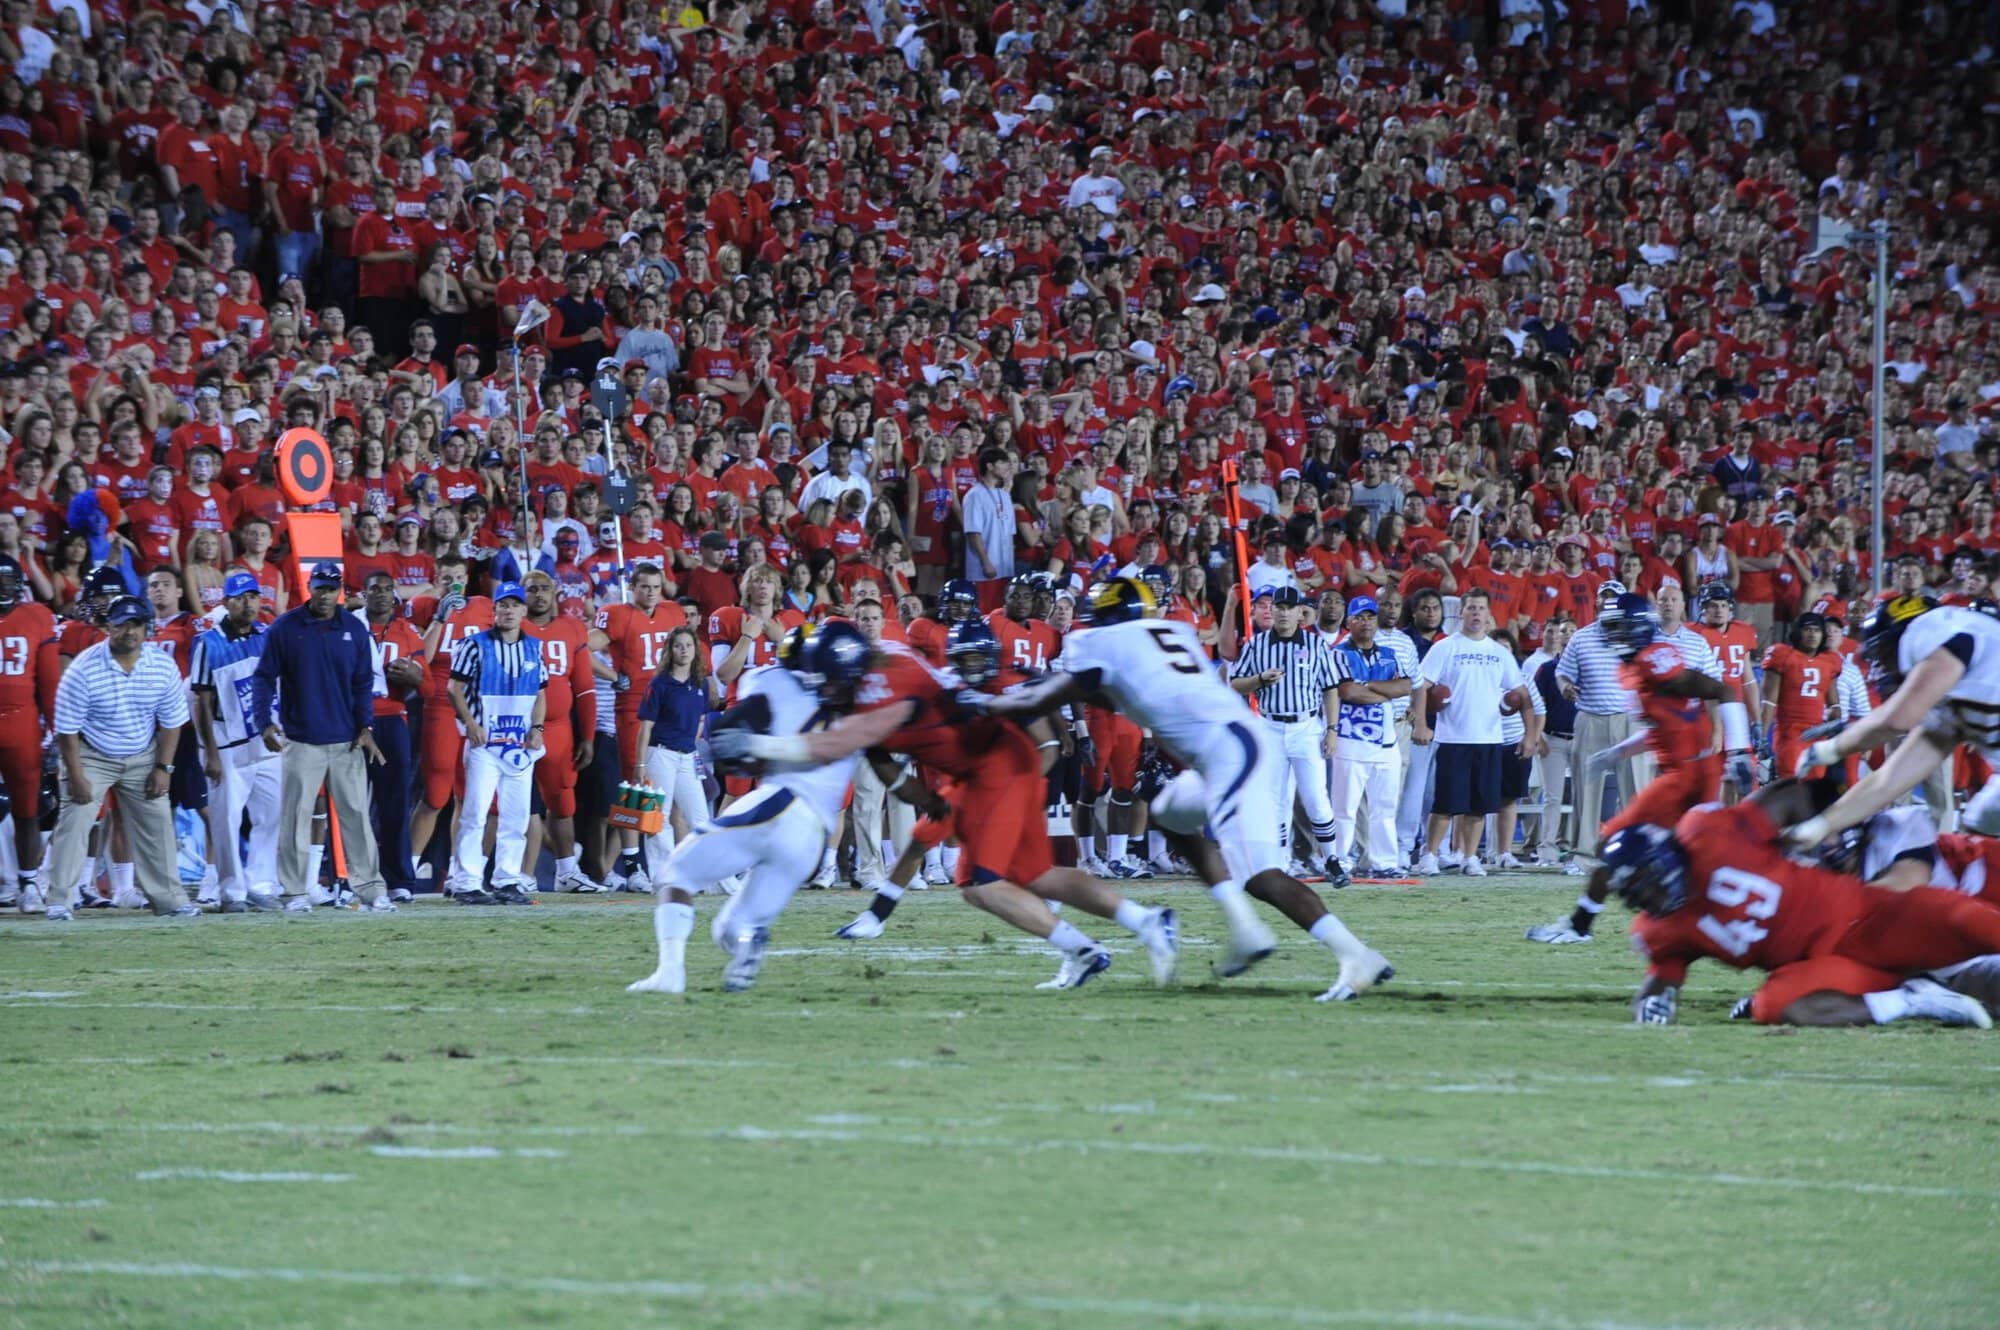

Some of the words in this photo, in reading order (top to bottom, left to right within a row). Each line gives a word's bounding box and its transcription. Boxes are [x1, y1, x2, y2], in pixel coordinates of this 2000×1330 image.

[1013, 638, 1047, 675] 54
[1145, 628, 1201, 674] 5
[1800, 667, 1821, 697] 2
[1339, 717, 1384, 741] 10
[1341, 704, 1384, 721] PAC
[1696, 865, 1783, 957] 49
